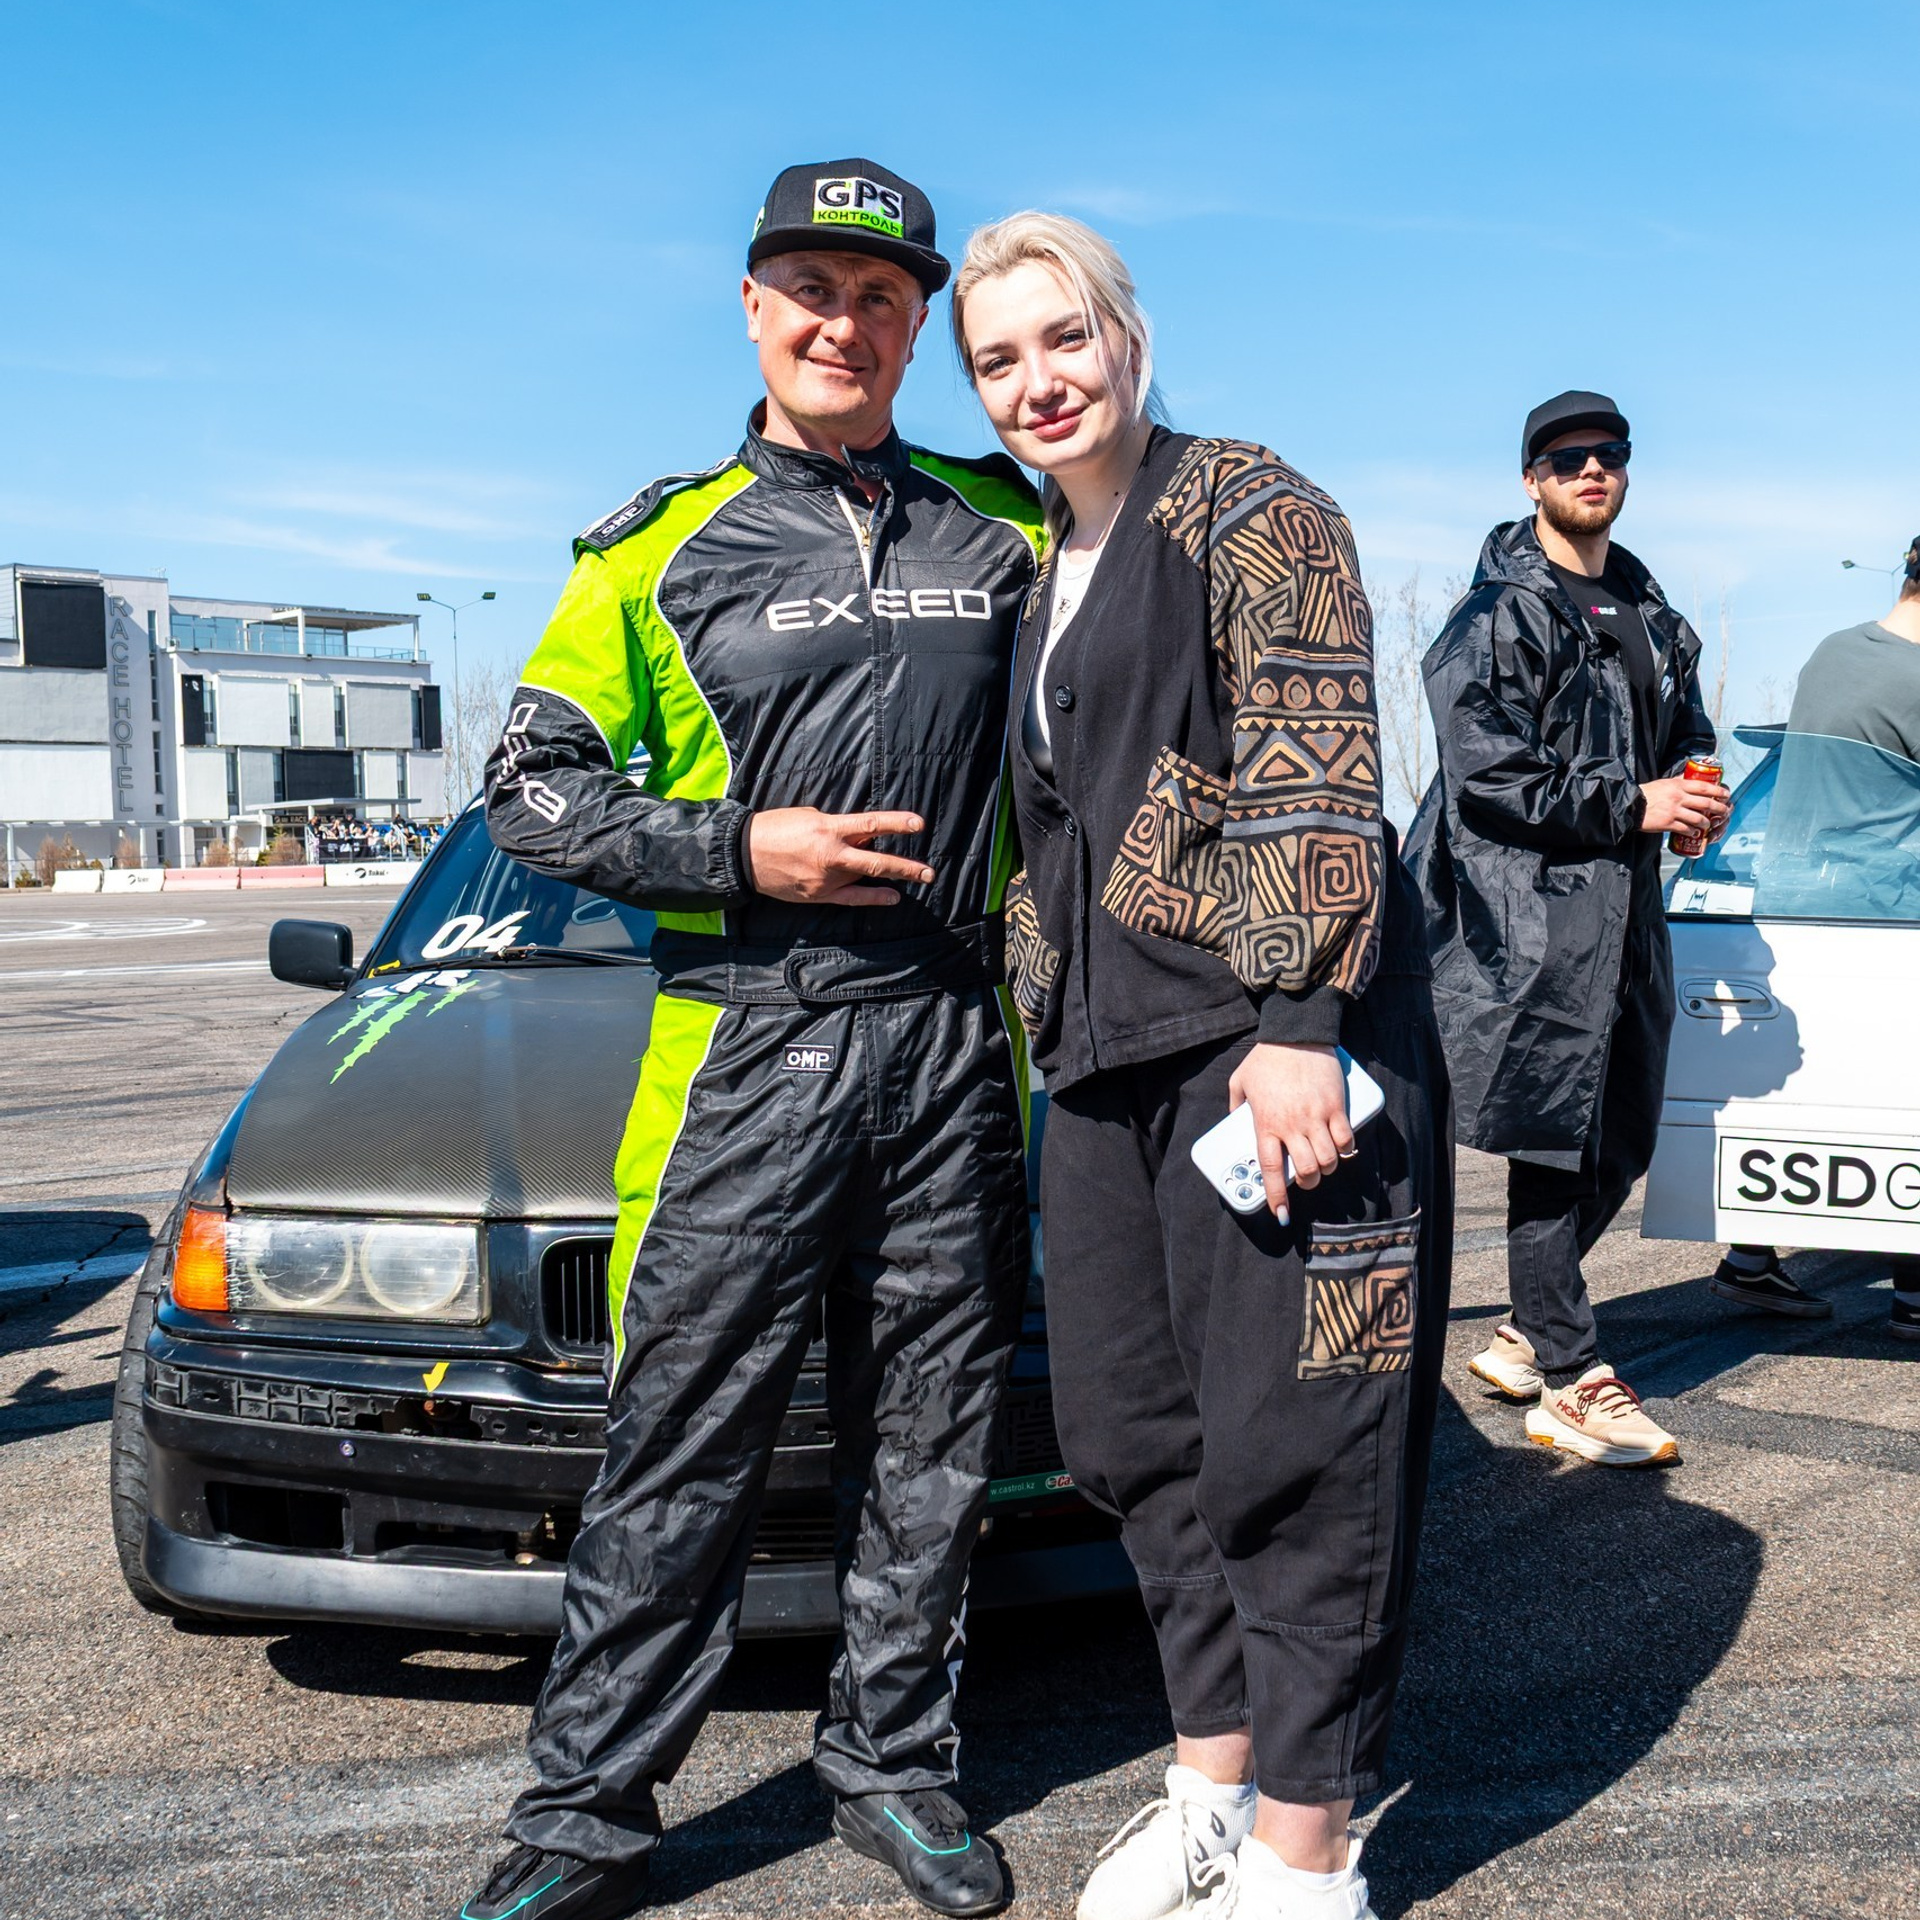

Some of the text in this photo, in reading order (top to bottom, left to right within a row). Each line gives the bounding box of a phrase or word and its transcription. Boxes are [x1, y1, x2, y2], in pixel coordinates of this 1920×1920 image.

[818, 180, 900, 219] GPS
[818, 211, 900, 234] КОНТРОЛЬ
[766, 588, 991, 631] EXEED
[110, 597, 133, 812] RACE HOTEL
[421, 911, 531, 958] 04
[787, 1050, 830, 1068] OMP
[1556, 1399, 1586, 1427] HOKA
